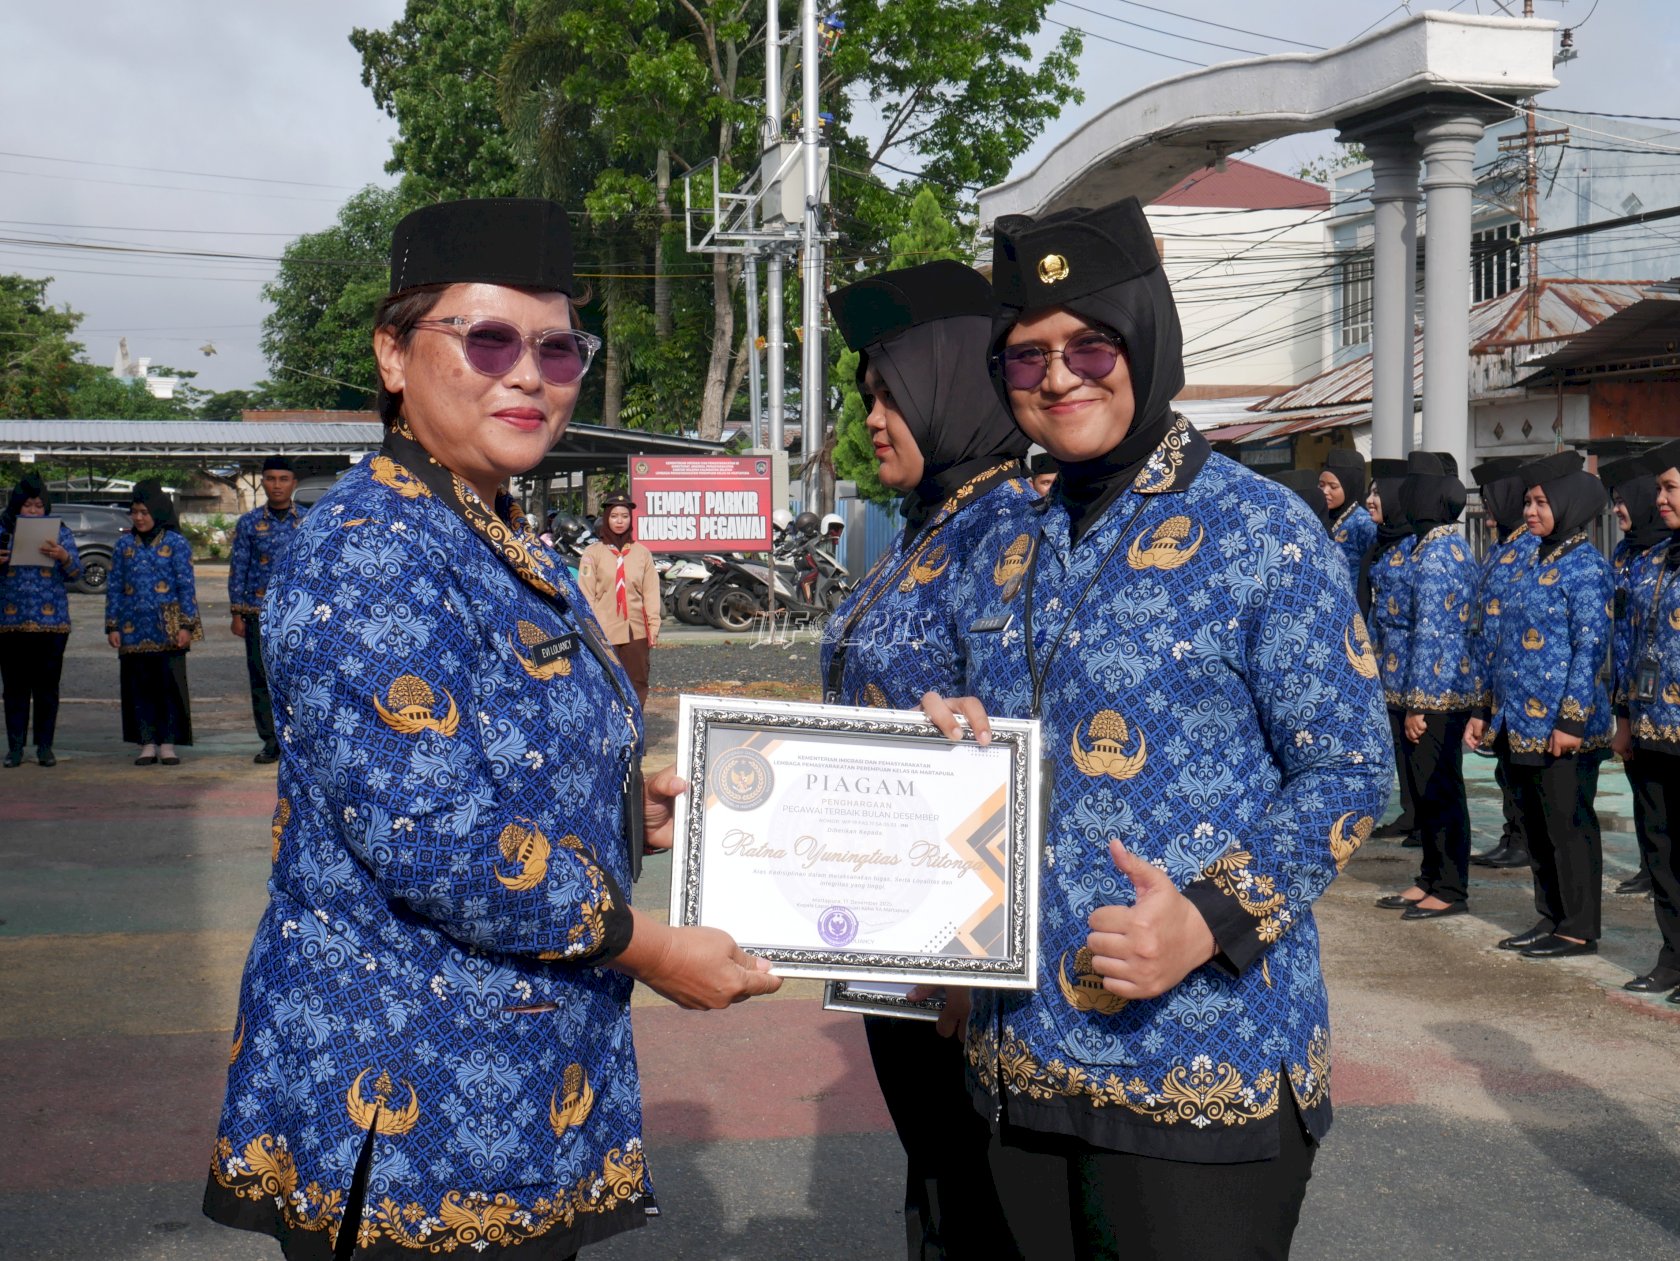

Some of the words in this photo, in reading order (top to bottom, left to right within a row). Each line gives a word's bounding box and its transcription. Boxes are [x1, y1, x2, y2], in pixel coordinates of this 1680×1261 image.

[645, 491, 701, 515] TEMPAT
[705, 491, 759, 515] PARKIR
[638, 516, 697, 540] KHUSUS
[700, 516, 766, 540] PEGAWAI
[541, 648, 551, 658] EVI
[798, 755, 838, 763] KEMENTERIAN
[879, 761, 931, 769] PEMASYARAKATAN
[802, 762, 856, 771] PEMASYARAKATAN
[920, 769, 955, 777] MARTAPURA
[806, 773, 915, 797] PIAGAM
[822, 798, 892, 809] PENGHARGAAN
[782, 805, 823, 815] PEGAWAI
[825, 807, 860, 817] TERBAIK
[862, 809, 891, 819] BULAN
[893, 811, 940, 822] DESEMBER
[721, 829, 787, 860] Ratna
[794, 835, 902, 873] Yuningtias
[908, 840, 984, 879] Ritonga
